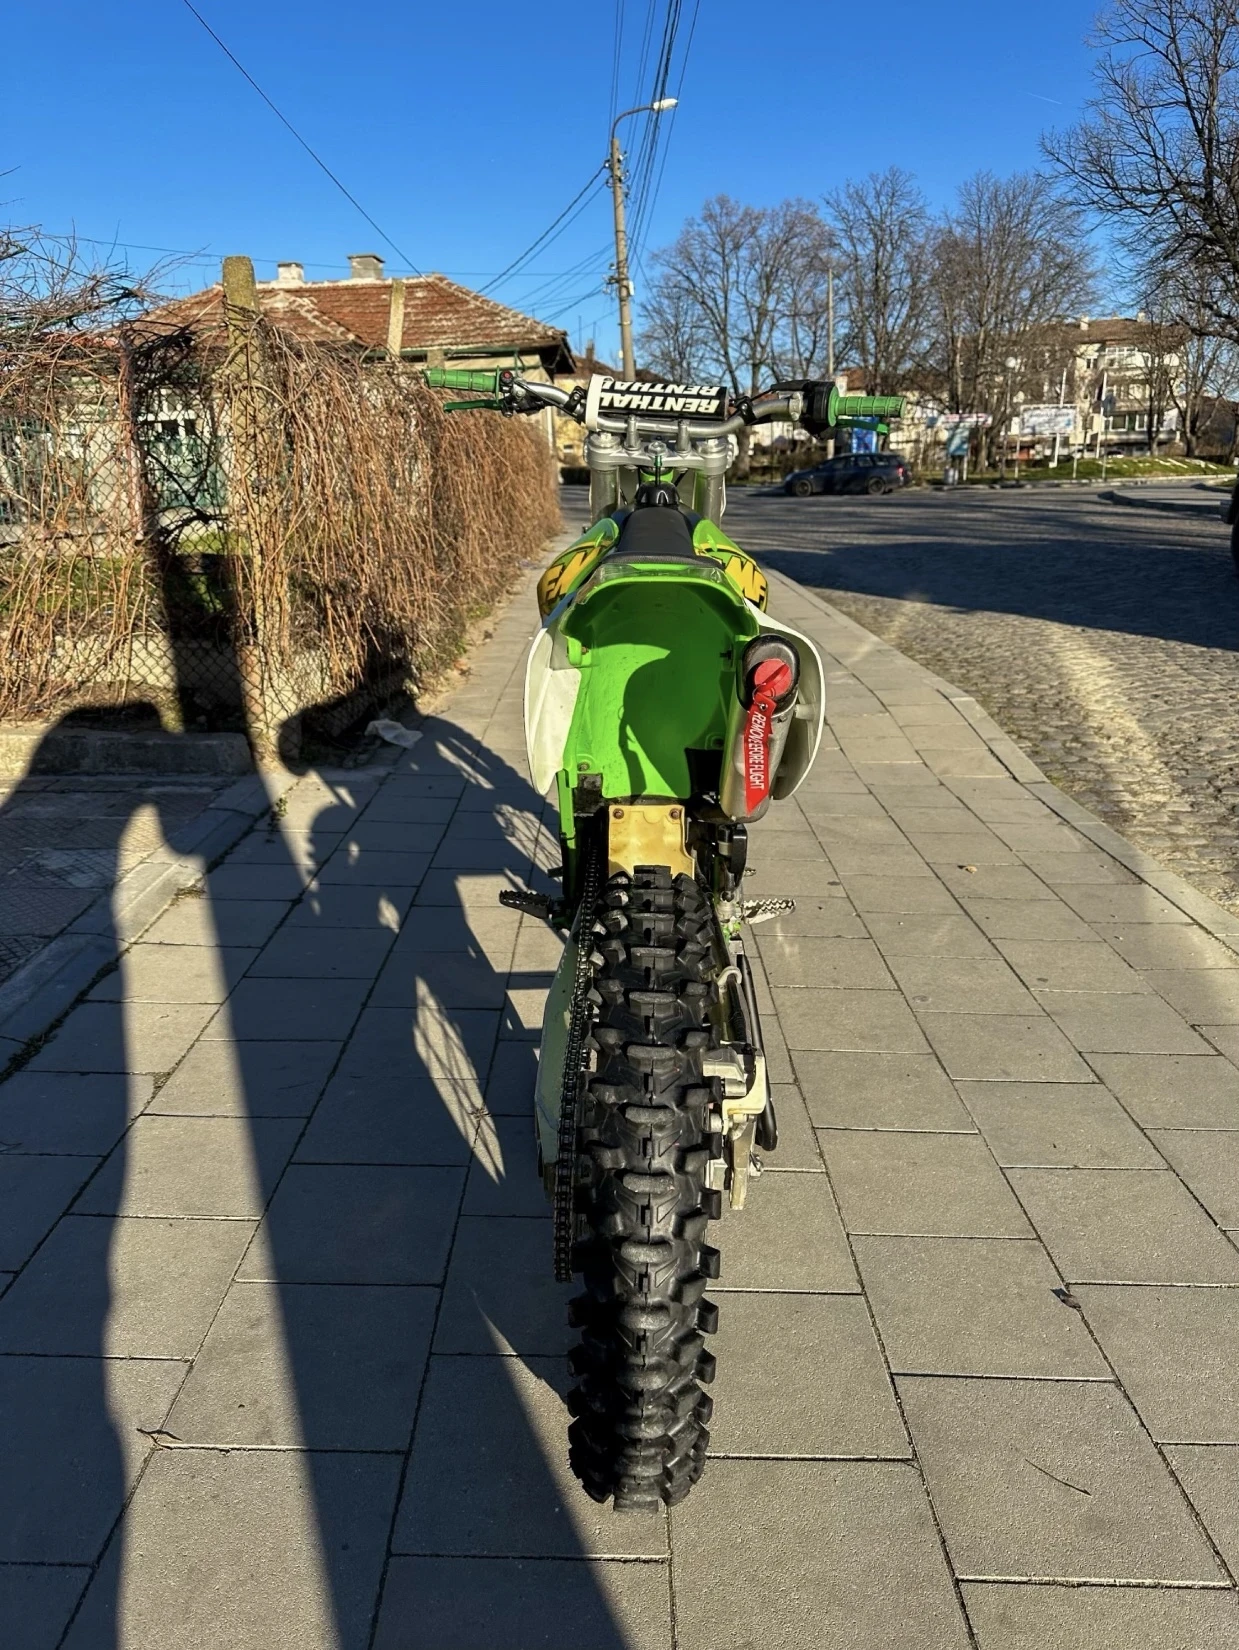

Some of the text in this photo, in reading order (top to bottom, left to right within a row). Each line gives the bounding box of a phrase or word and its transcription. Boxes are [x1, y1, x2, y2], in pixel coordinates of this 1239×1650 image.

[601, 380, 720, 397] RENTHAL
[600, 391, 720, 414] RENTHAL
[724, 555, 768, 604] MF
[748, 743, 765, 764] EFORE
[749, 764, 765, 790] FLIGHT
